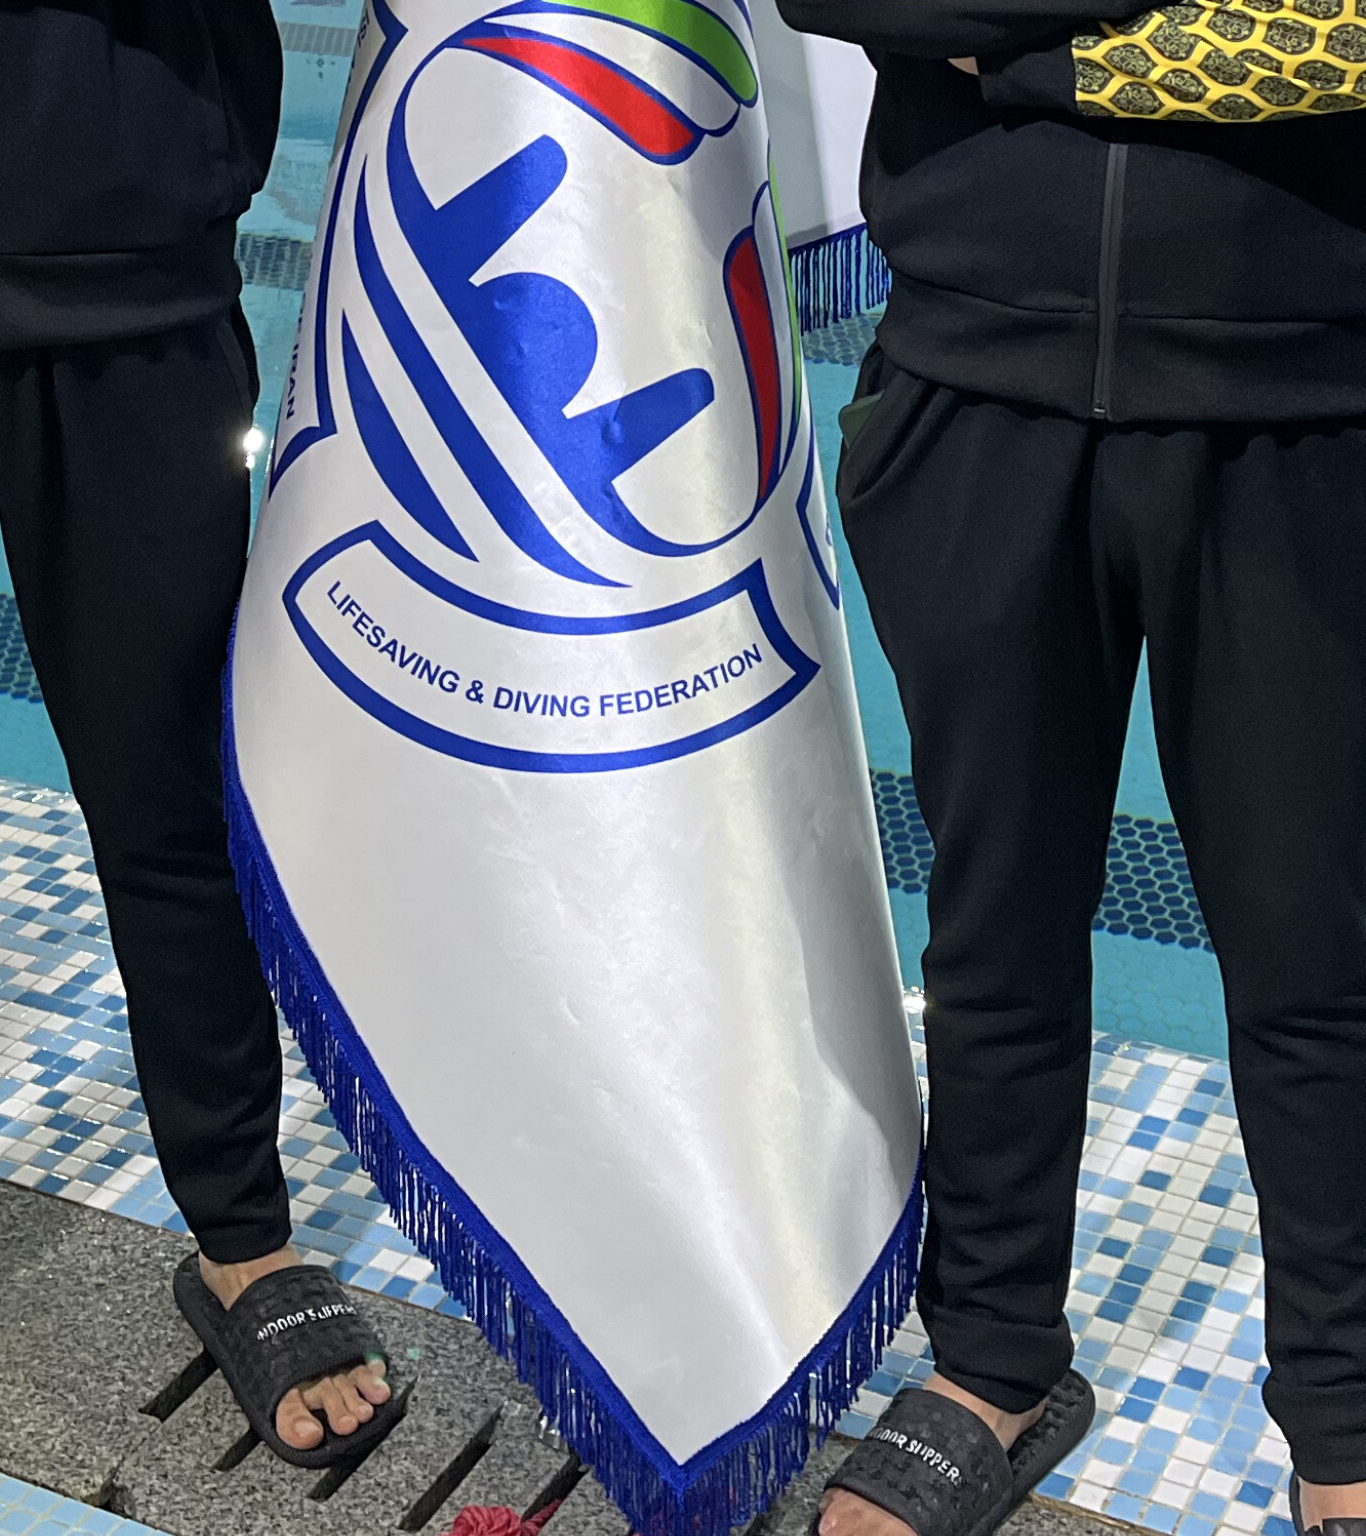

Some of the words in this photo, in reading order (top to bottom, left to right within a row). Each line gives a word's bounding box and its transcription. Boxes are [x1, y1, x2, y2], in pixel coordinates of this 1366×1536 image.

[327, 580, 460, 693] LIFESAVING
[465, 679, 484, 704] &
[493, 686, 590, 717] DIVING
[600, 643, 764, 716] FEDERATION
